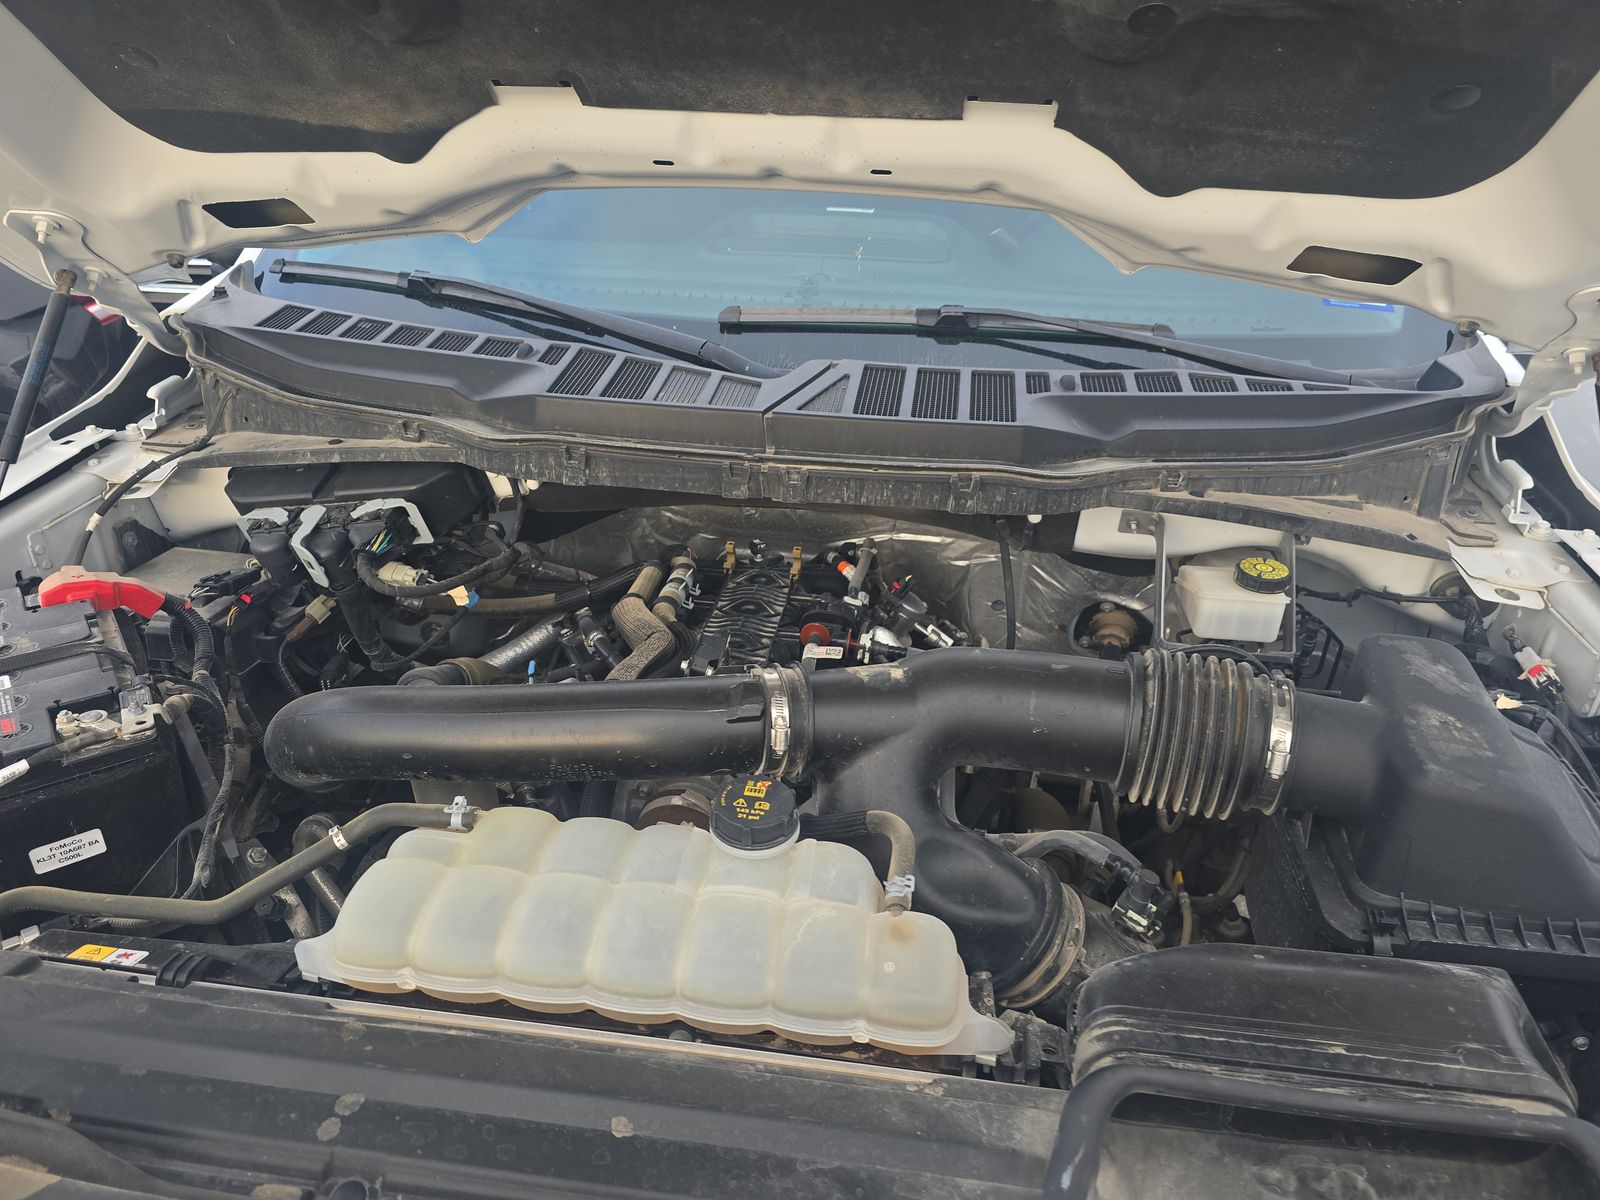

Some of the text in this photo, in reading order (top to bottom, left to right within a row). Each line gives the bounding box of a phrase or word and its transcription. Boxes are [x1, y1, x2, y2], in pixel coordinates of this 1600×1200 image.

[36, 839, 100, 864] KL3T 10A687 BA
[49, 838, 83, 852] FoMoCo
[58, 852, 83, 863] C500L
